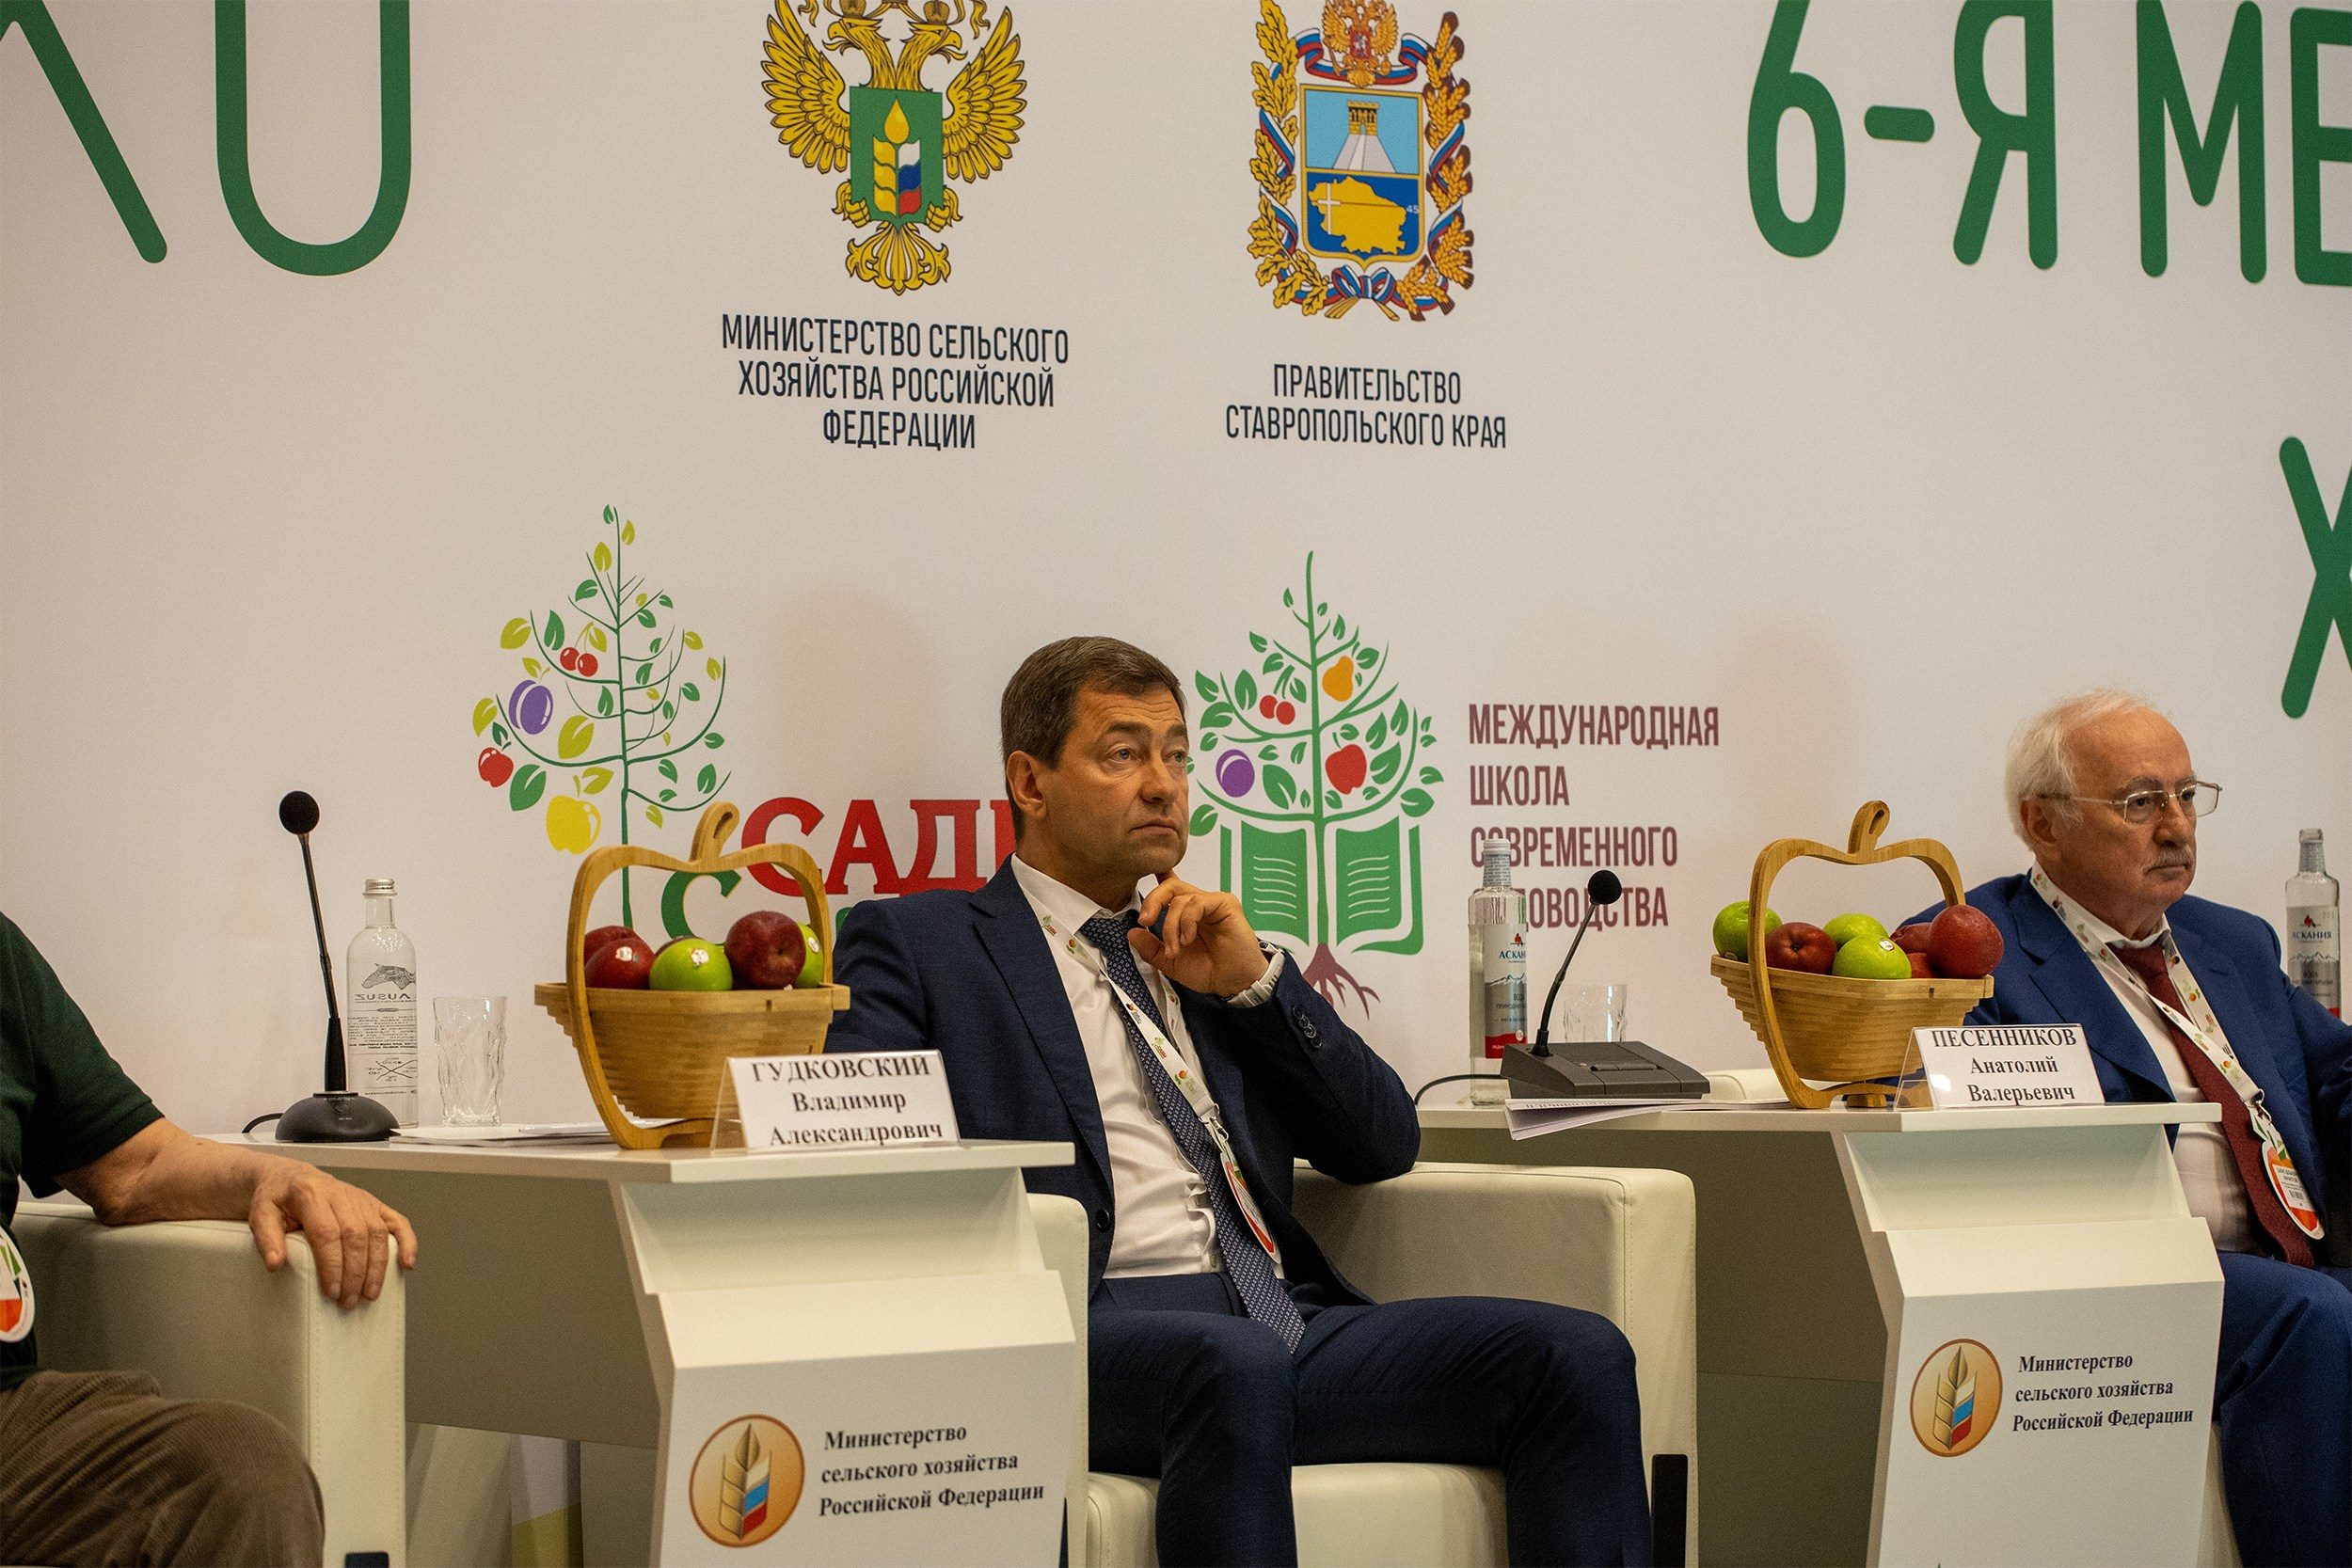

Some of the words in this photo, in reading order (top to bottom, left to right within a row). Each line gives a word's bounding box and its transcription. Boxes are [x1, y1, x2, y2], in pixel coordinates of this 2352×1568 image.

[1747, 0, 2058, 271] 6-Я
[1406, 204, 1419, 214] 45
[722, 313, 922, 357] МИНИСТЕРСТВО
[929, 324, 1069, 364] СЕЛЬСКОГО
[738, 356, 885, 401] ХОЗЯЙСТВА
[892, 363, 1055, 407] РОССИЙСКОЙ
[1273, 363, 1461, 404] ПРАВИТЕЛЬСТВО
[822, 409, 976, 451] ФЕДЕРАЦИИ
[1226, 404, 1444, 447] СТАВРОПОЛЬСКОГО
[1452, 414, 1507, 449] КРАЯ
[1469, 704, 1720, 750] МЕЖДУНАРОДНАЯ
[1470, 765, 1570, 806] ШКОЛА
[1931, 1028, 2077, 1048] ПЕСЕННИКОВ
[752, 1055, 930, 1084] ГУДКОВСКИЙ
[1971, 1056, 2058, 1074] Анатолий
[791, 1092, 906, 1113] Владимир
[1966, 1084, 2075, 1105] Валерьевич
[771, 1123, 943, 1146] Александрович
[2018, 1354, 2133, 1374] Министерство
[2015, 1386, 2092, 1402] сельского
[2097, 1380, 2173, 1399] хозяйства
[2012, 1411, 2103, 1432] Российской
[2107, 1410, 2193, 1429] Федерации
[824, 1426, 967, 1450] Министерство
[821, 1463, 917, 1483] сельского
[923, 1454, 1019, 1476] хозяйства
[818, 1490, 931, 1516] Российской
[938, 1484, 1044, 1508] Федерации
